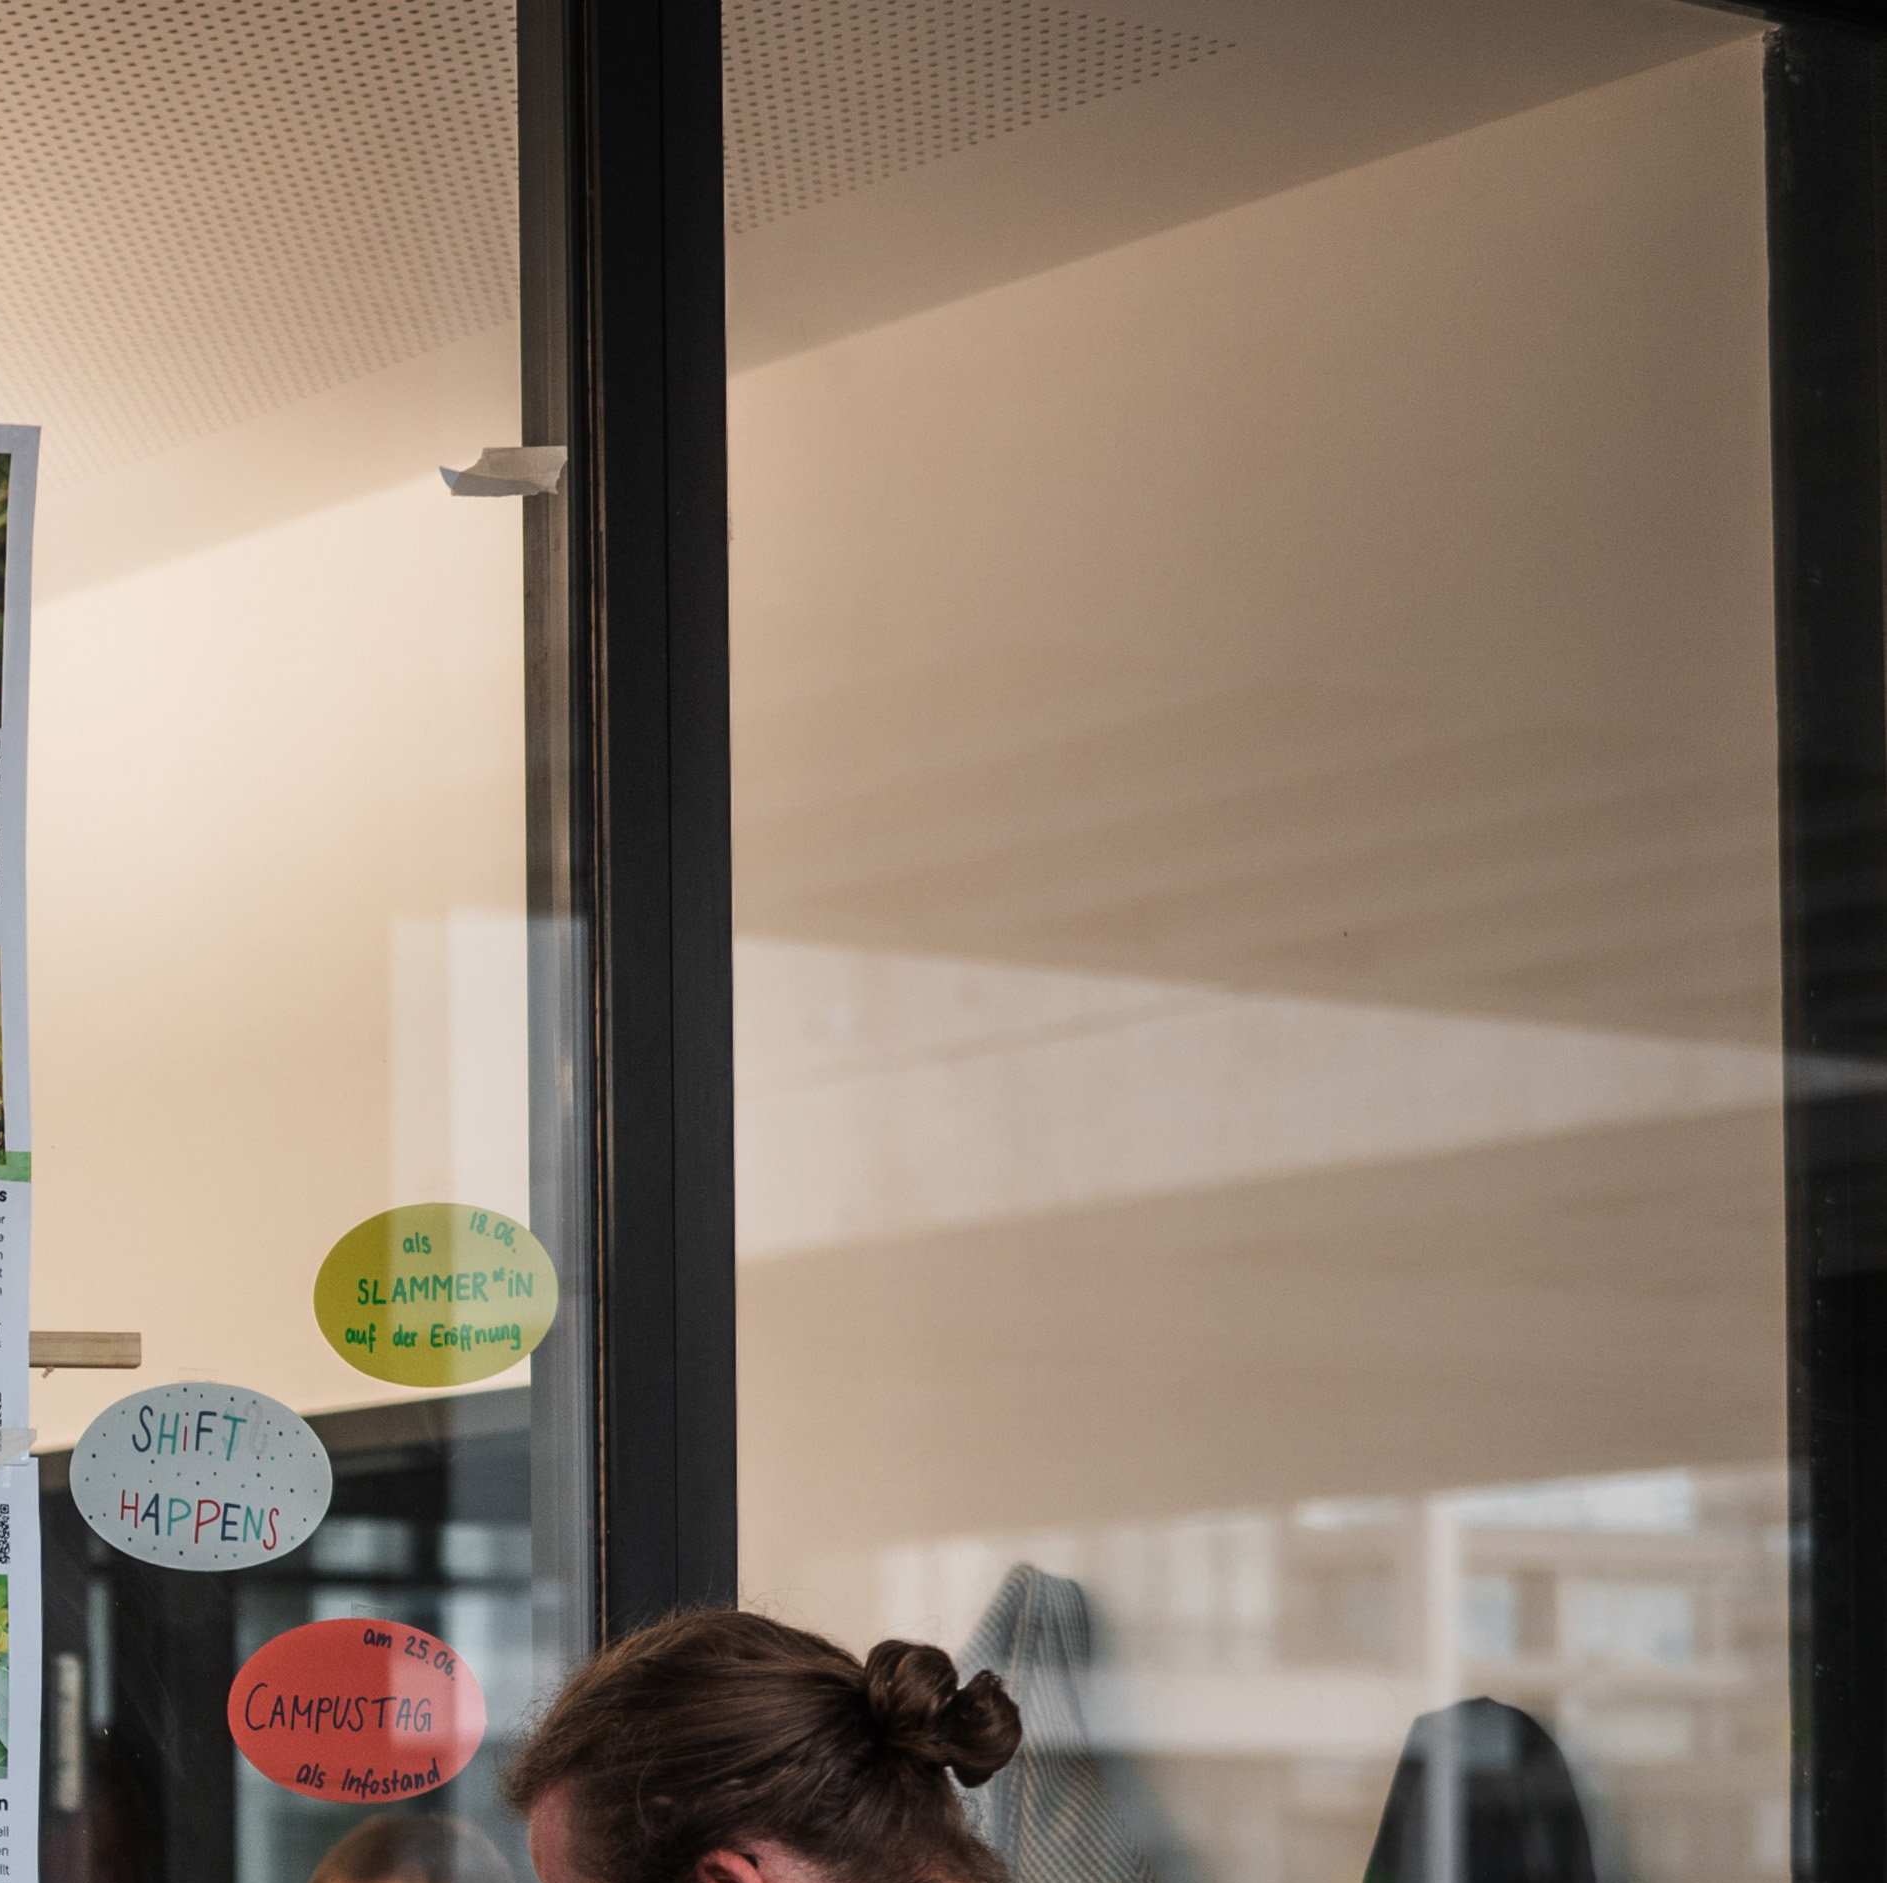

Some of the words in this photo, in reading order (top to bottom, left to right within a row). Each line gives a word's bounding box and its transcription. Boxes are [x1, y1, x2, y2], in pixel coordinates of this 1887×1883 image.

[403, 1233, 432, 1254] als
[345, 1323, 376, 1353] auf
[393, 1324, 417, 1347] der
[430, 1323, 521, 1351] Eröffnung
[120, 1489, 279, 1550] HAPPENS
[363, 1628, 392, 1648] am
[296, 1763, 326, 1788] als
[341, 1757, 441, 1799] Infostand
